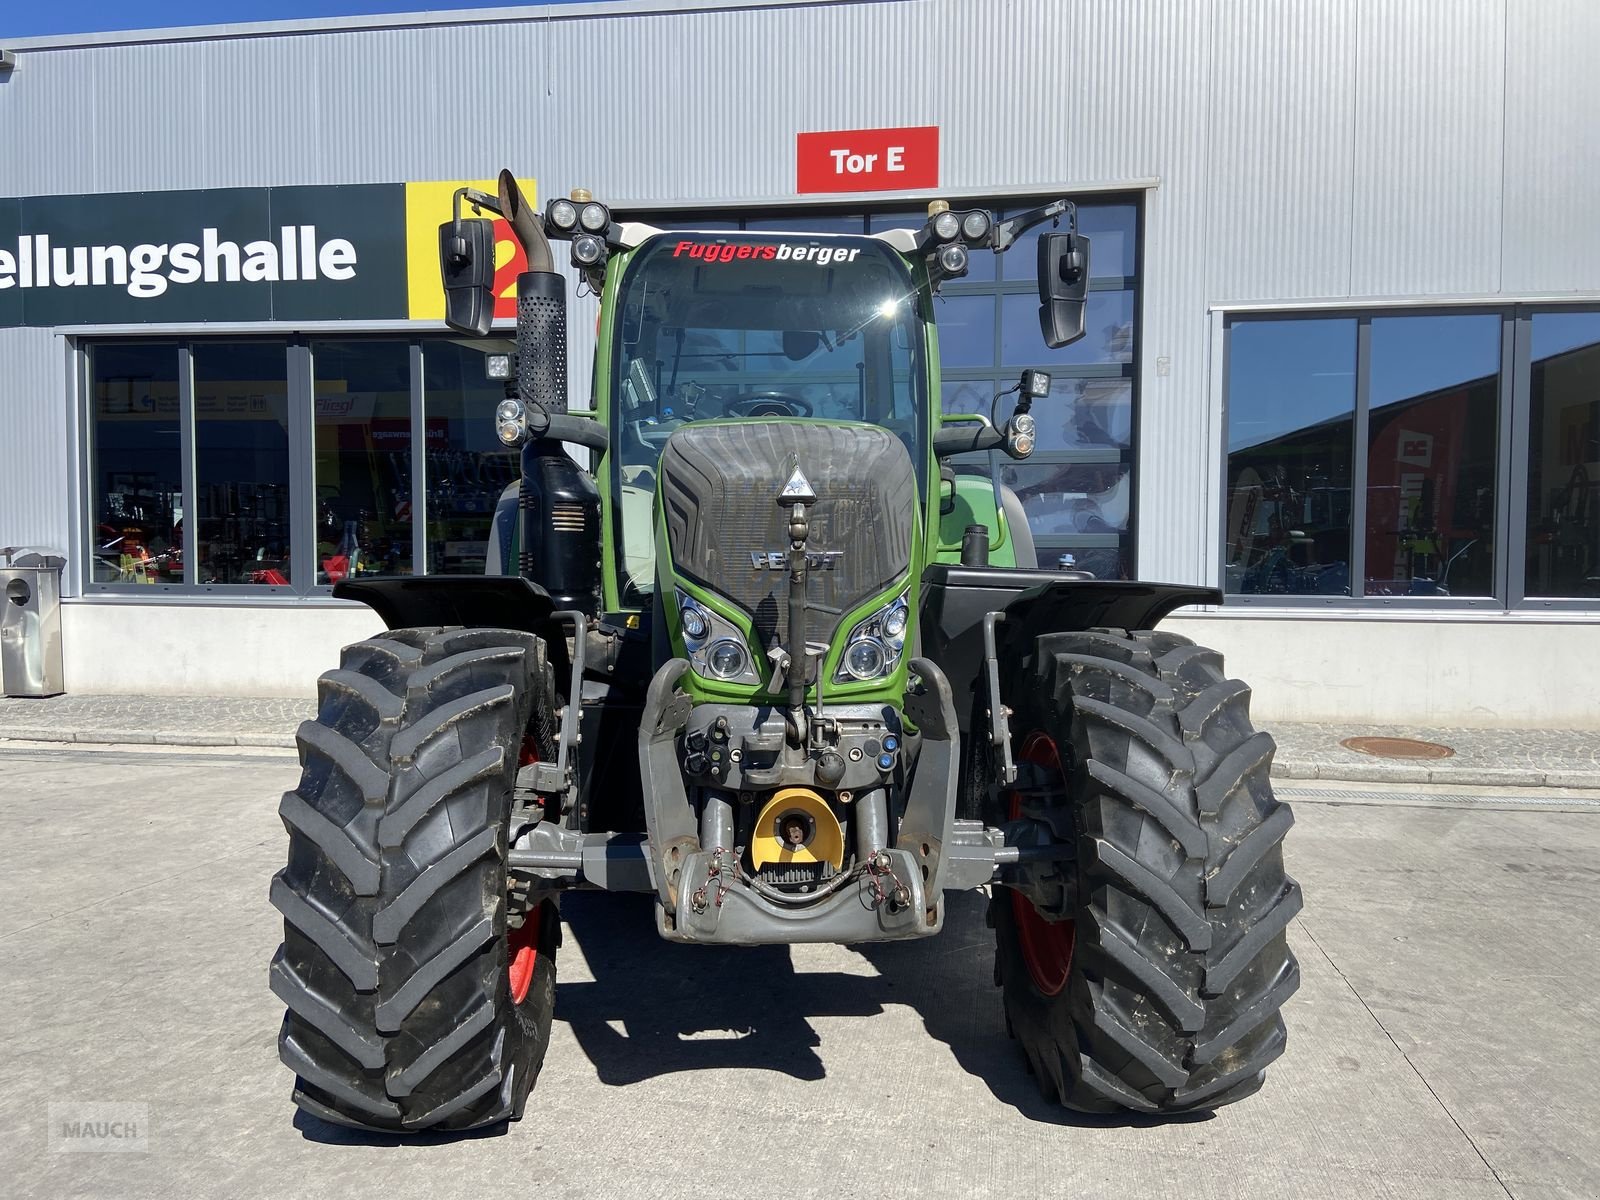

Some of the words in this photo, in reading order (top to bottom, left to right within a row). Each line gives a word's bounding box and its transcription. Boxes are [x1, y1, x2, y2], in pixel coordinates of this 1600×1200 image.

[830, 149, 877, 174] Tor
[887, 146, 905, 171] E
[673, 241, 860, 265] Fuggersberger
[751, 551, 843, 571] FEDT
